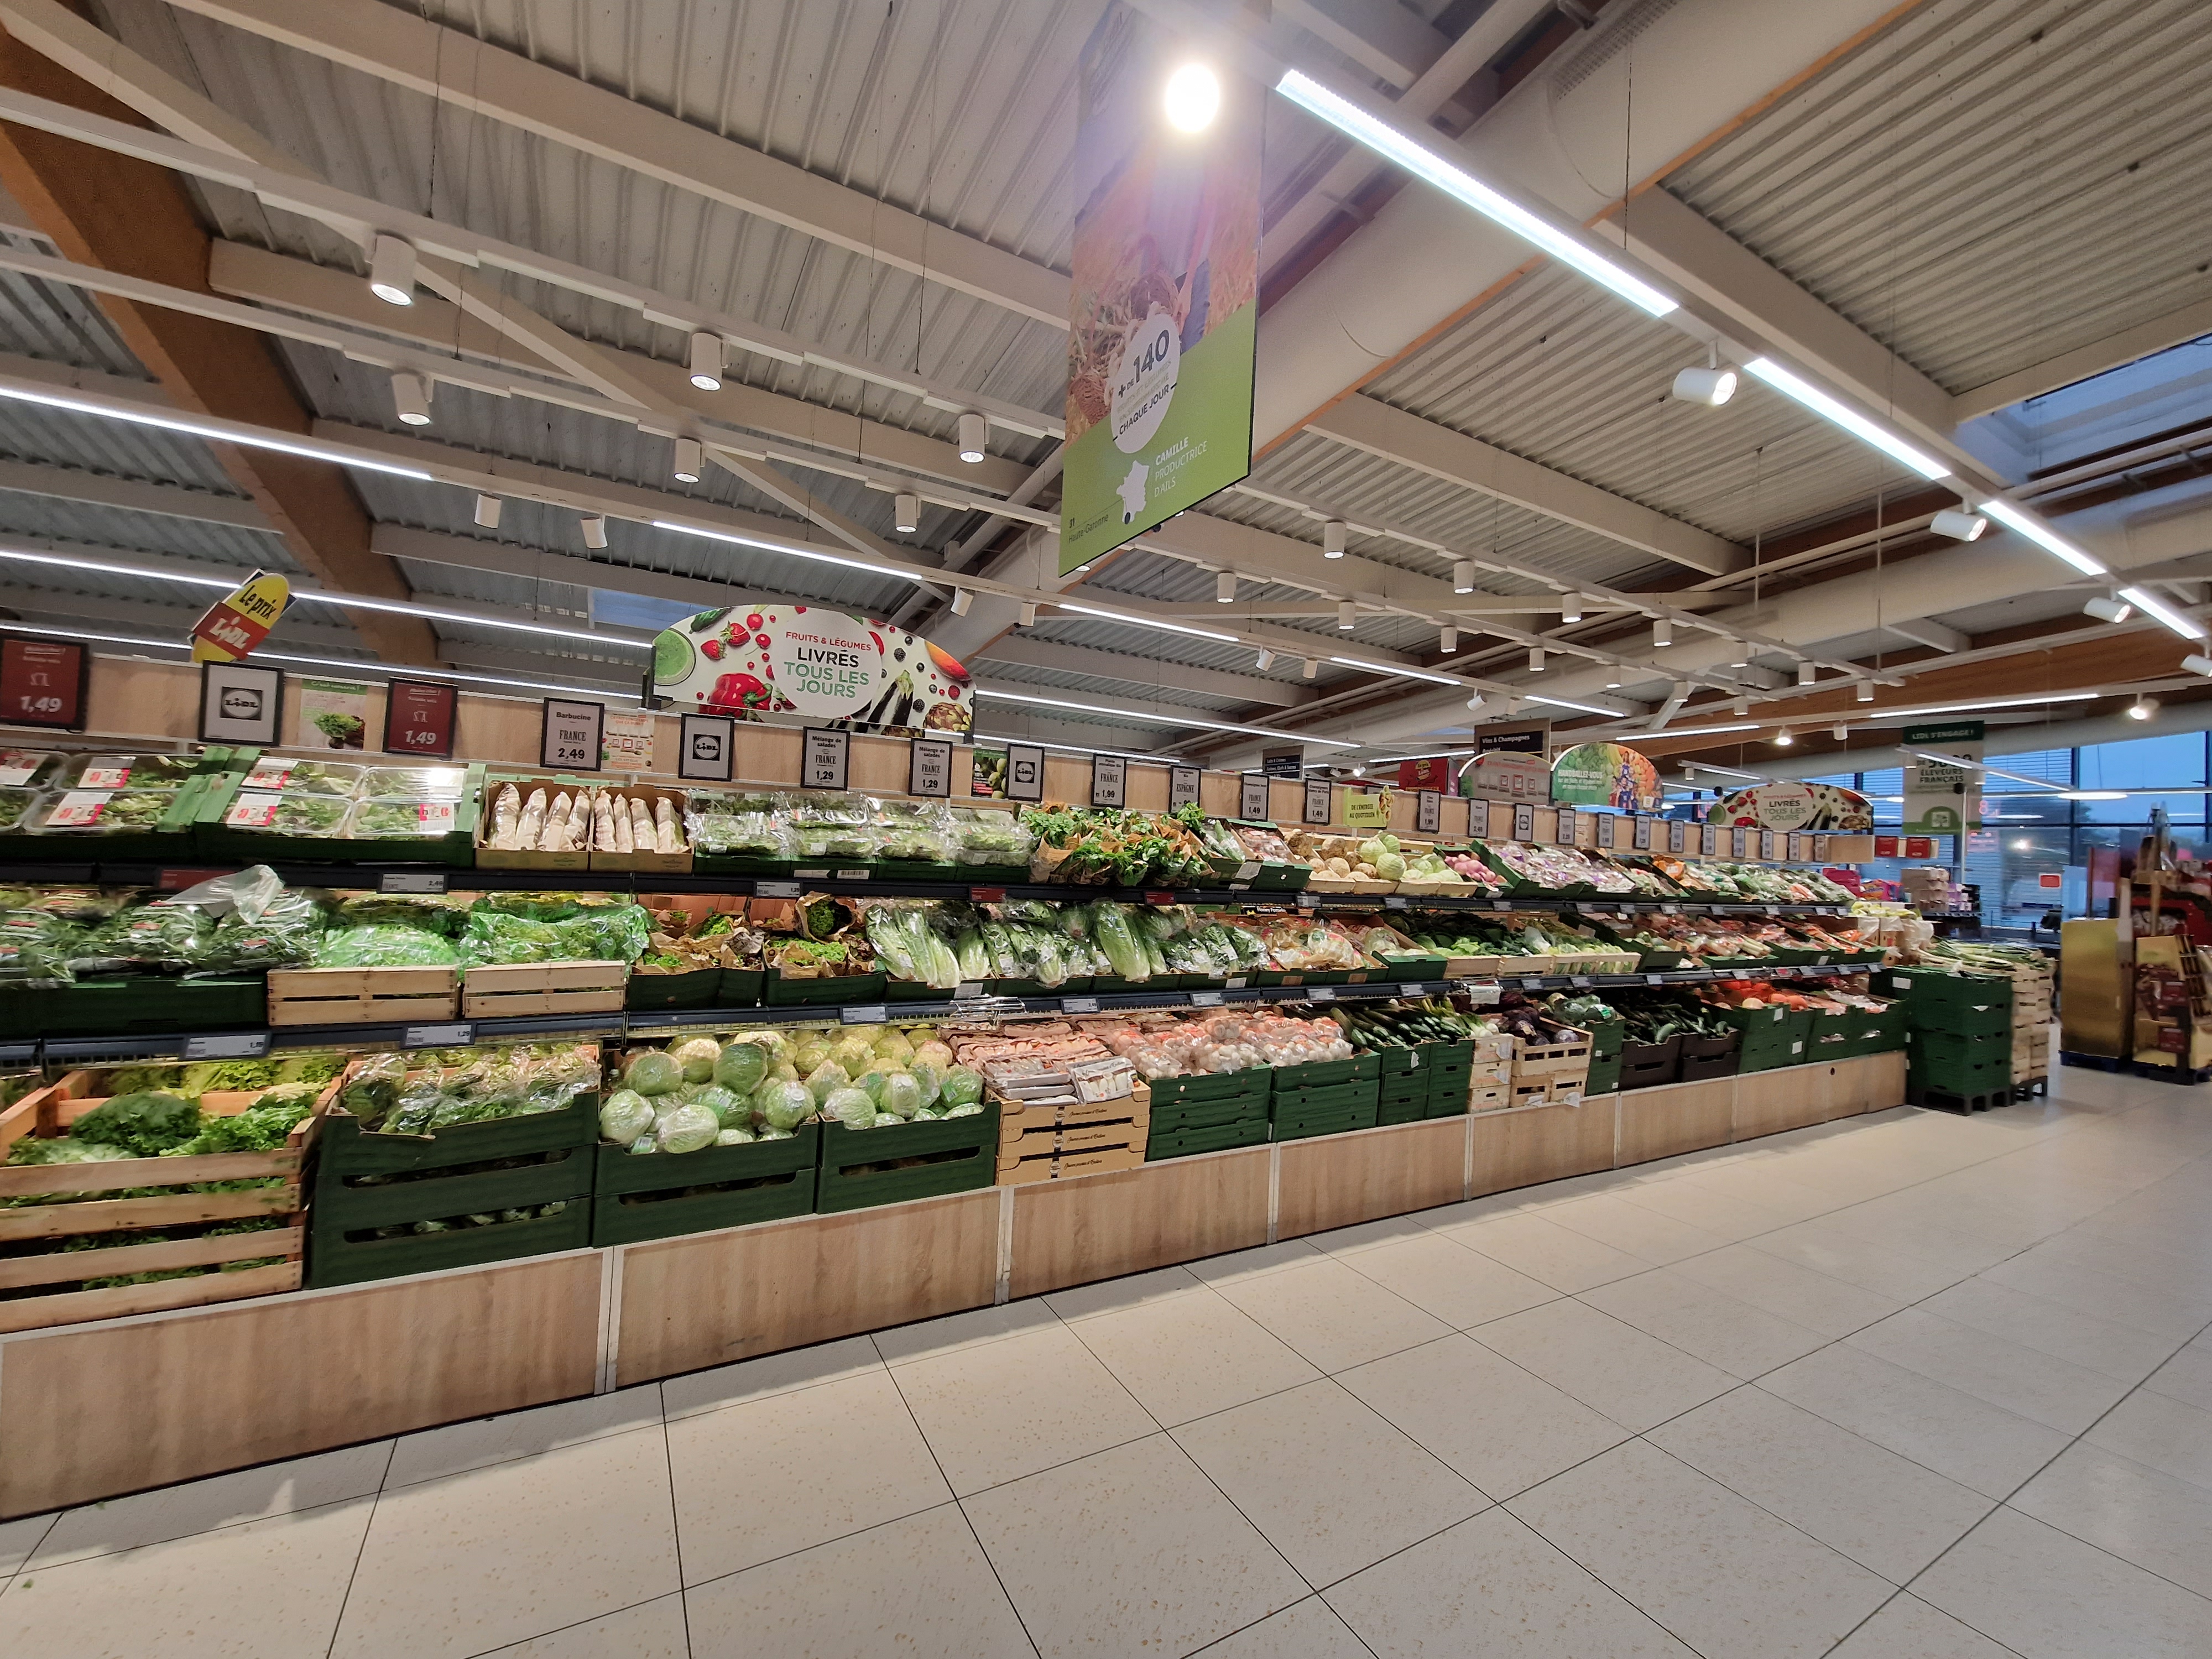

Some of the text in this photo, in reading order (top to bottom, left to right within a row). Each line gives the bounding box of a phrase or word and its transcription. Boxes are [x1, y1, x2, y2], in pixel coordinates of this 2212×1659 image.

[1127, 378, 1134, 390] DE
[1134, 330, 1170, 383] 140
[1119, 384, 1169, 435] CHAQUE JOUR
[1156, 436, 1188, 466] CAMILLE
[1155, 440, 1207, 482] PRODUCTRICE
[1154, 476, 1176, 497] D'AILS
[1068, 514, 1109, 544] Haute-Garonne
[1069, 517, 1075, 529] 31
[238, 584, 277, 620] Le prix
[785, 631, 819, 644] FRUITS
[829, 637, 872, 651] LÉGUMES
[797, 647, 859, 668] LIVRÉS
[784, 661, 869, 685] TOUS LES
[796, 679, 856, 698] JOURS
[20, 695, 63, 713] 1,49
[556, 711, 592, 721] Barbucine
[405, 730, 436, 745] 1,49
[559, 729, 587, 742] FRANCE
[557, 747, 585, 759] 2,49
[815, 754, 836, 764] FRANCE
[816, 770, 834, 780] 1,29
[922, 764, 941, 774] FRANCE
[1558, 769, 1603, 779] HANDBALLEZ-VOUS
[922, 779, 938, 789] 1,29
[1100, 773, 1119, 783] FRANCE
[1102, 789, 1115, 798] 1,99
[1176, 783, 1194, 794] ESPAGNE
[1249, 794, 1261, 802] FRANCE
[1769, 799, 1801, 807] LIVRÉS
[1249, 806, 1260, 815] 1,49
